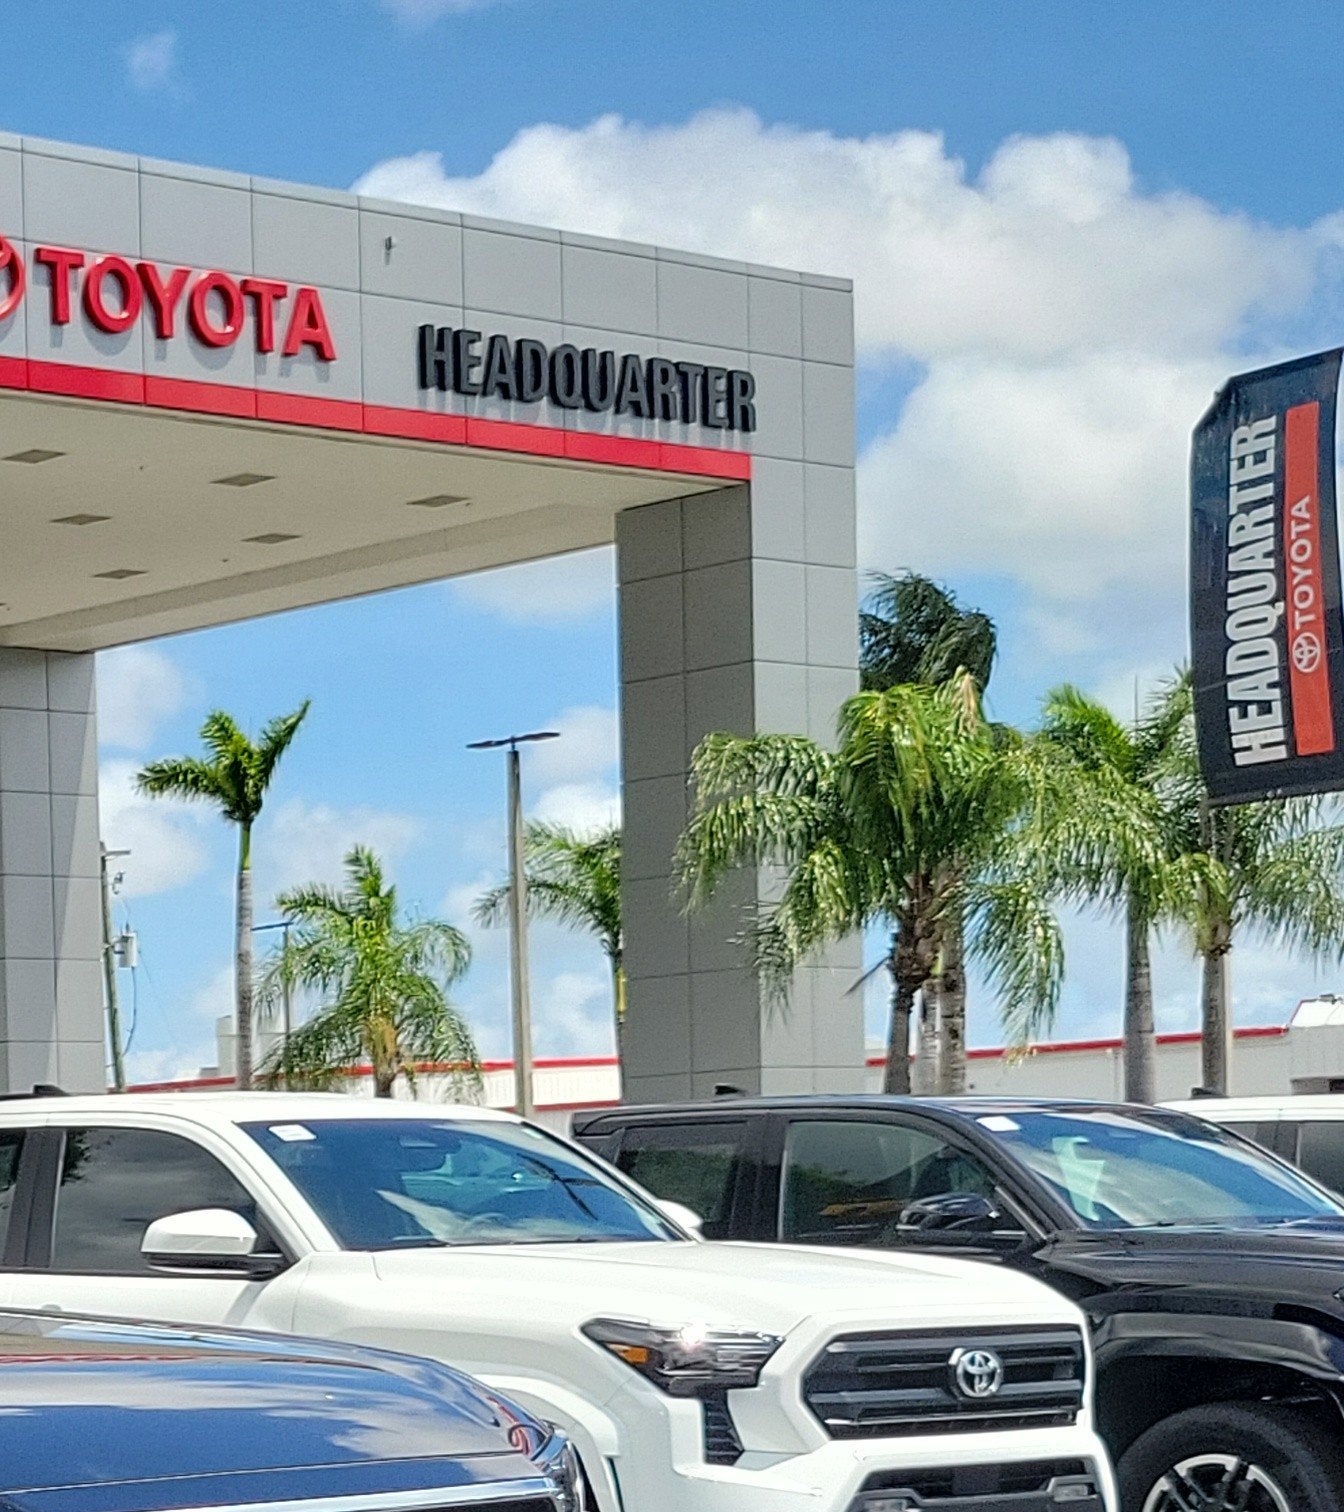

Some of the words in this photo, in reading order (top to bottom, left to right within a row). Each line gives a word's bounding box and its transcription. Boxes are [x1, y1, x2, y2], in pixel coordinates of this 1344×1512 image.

[35, 247, 337, 362] TOYOTA
[418, 324, 756, 432] HEADQUARTER
[1226, 415, 1288, 766] HEADQUARTER
[1290, 495, 1316, 631] TOYOTA
